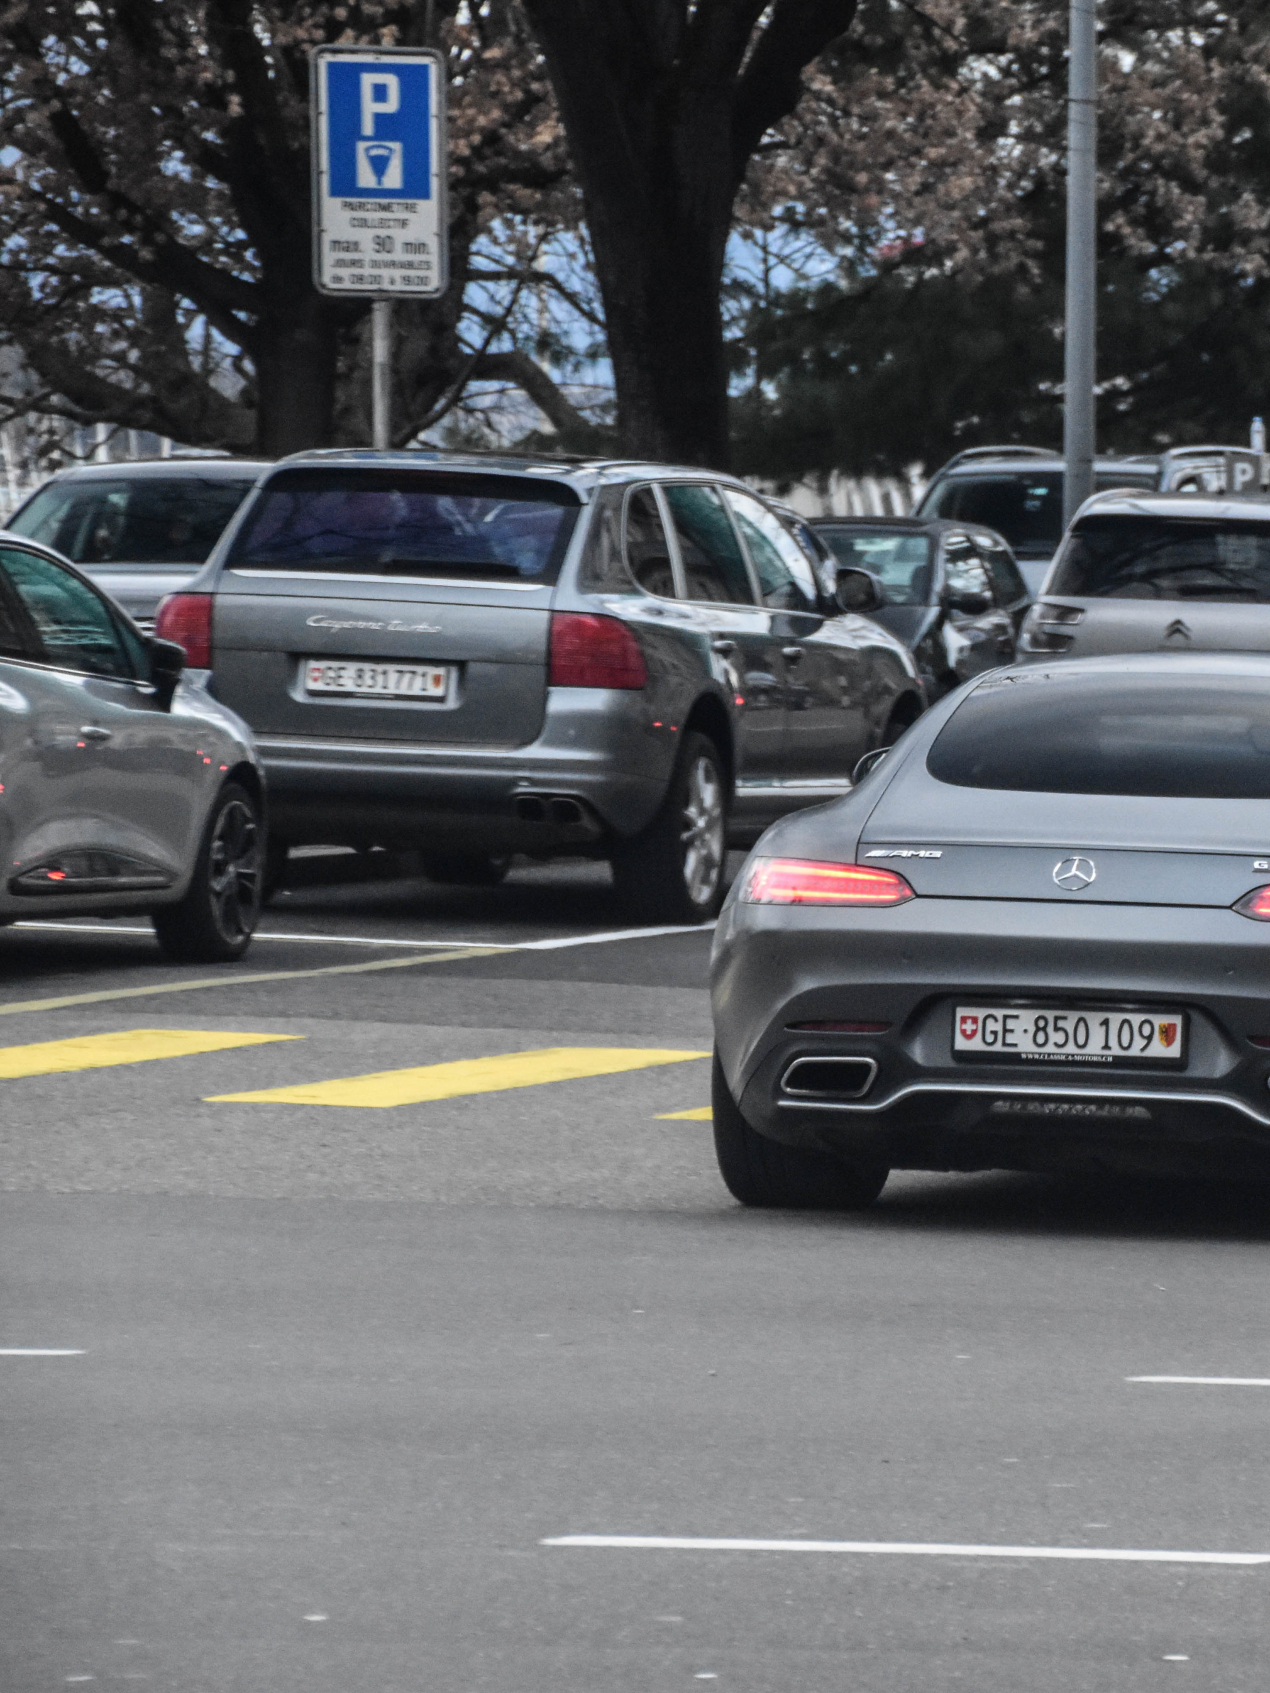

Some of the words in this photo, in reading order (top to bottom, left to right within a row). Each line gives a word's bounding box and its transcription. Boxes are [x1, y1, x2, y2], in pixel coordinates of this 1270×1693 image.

[360, 72, 400, 137] P
[372, 235, 396, 254] 90
[889, 850, 943, 858] AMG
